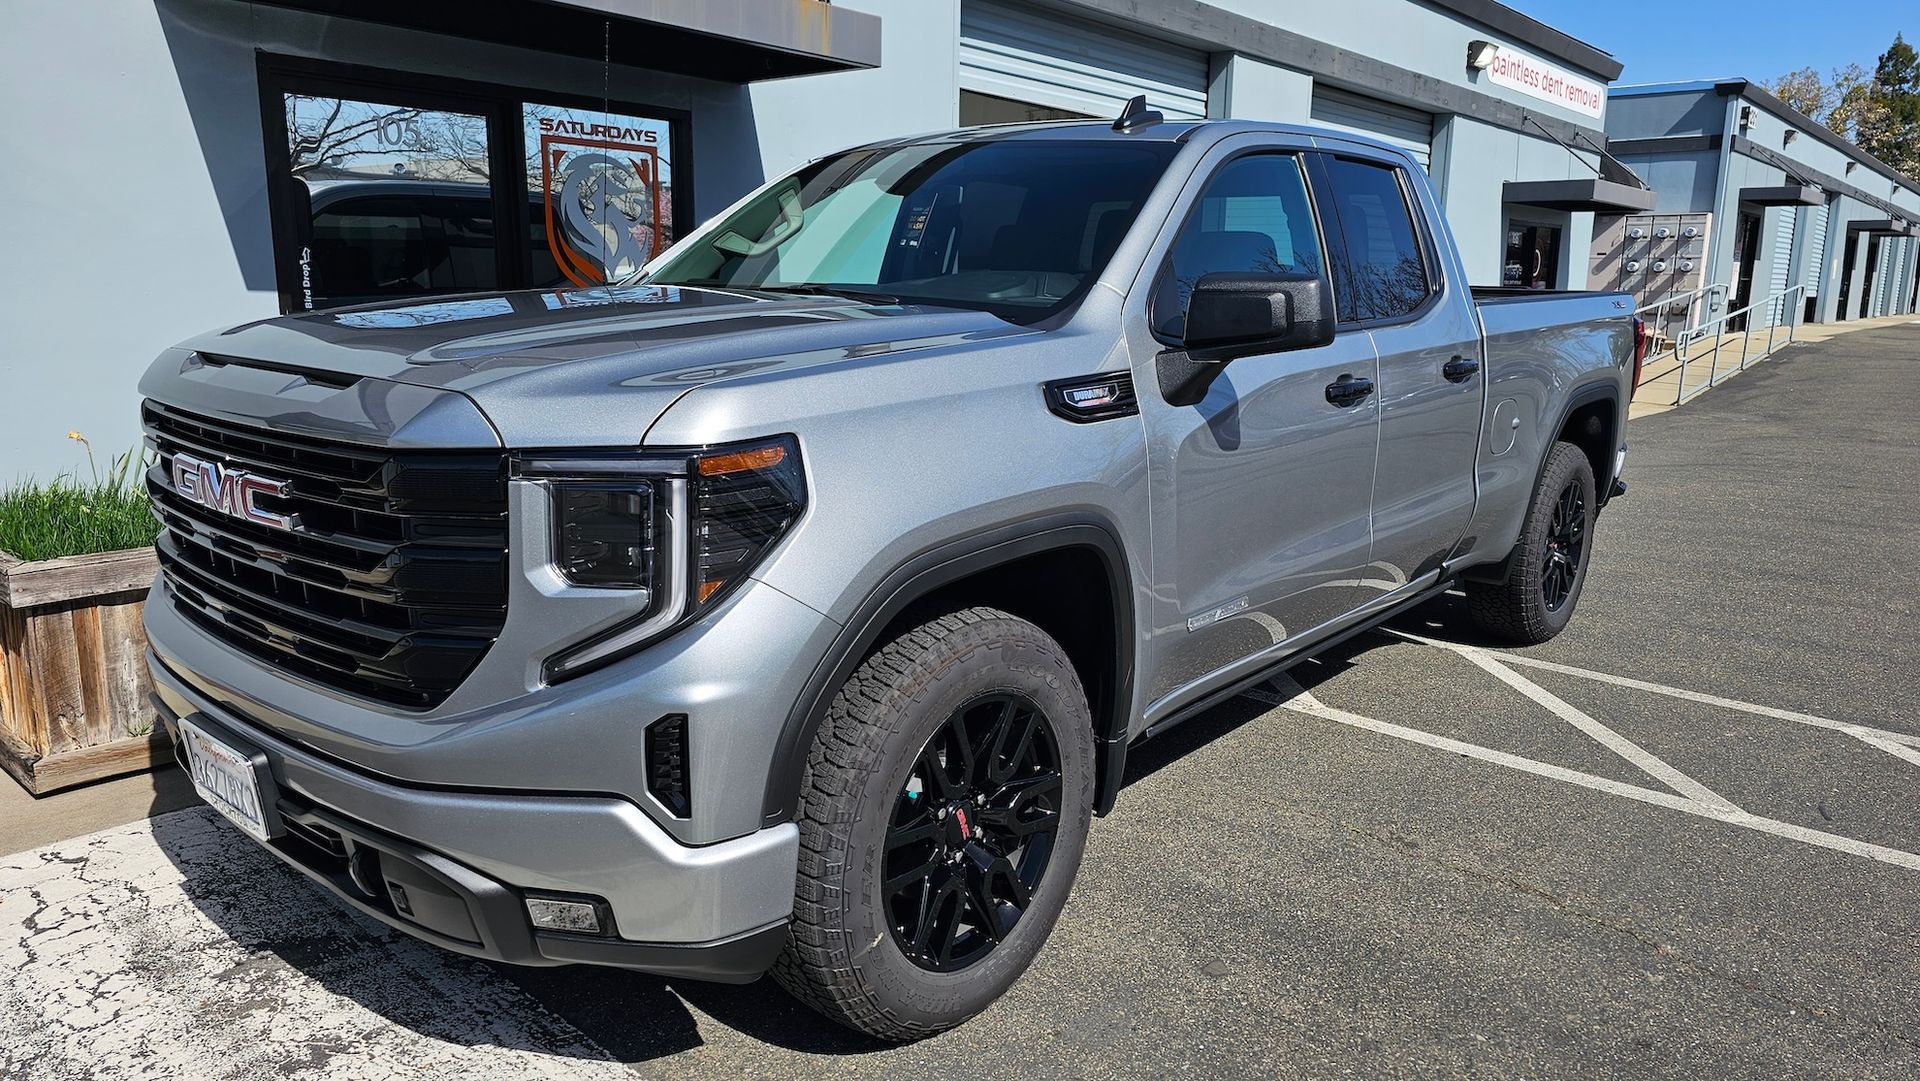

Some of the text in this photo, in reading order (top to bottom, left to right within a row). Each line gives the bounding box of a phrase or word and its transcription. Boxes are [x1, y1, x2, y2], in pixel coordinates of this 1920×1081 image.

[1492, 54, 1600, 111] paintless dent removal
[372, 116, 421, 148] 105
[539, 118, 657, 143] SATURDAYS
[302, 264, 313, 309] Bird Drop
[172, 452, 297, 532] GMC
